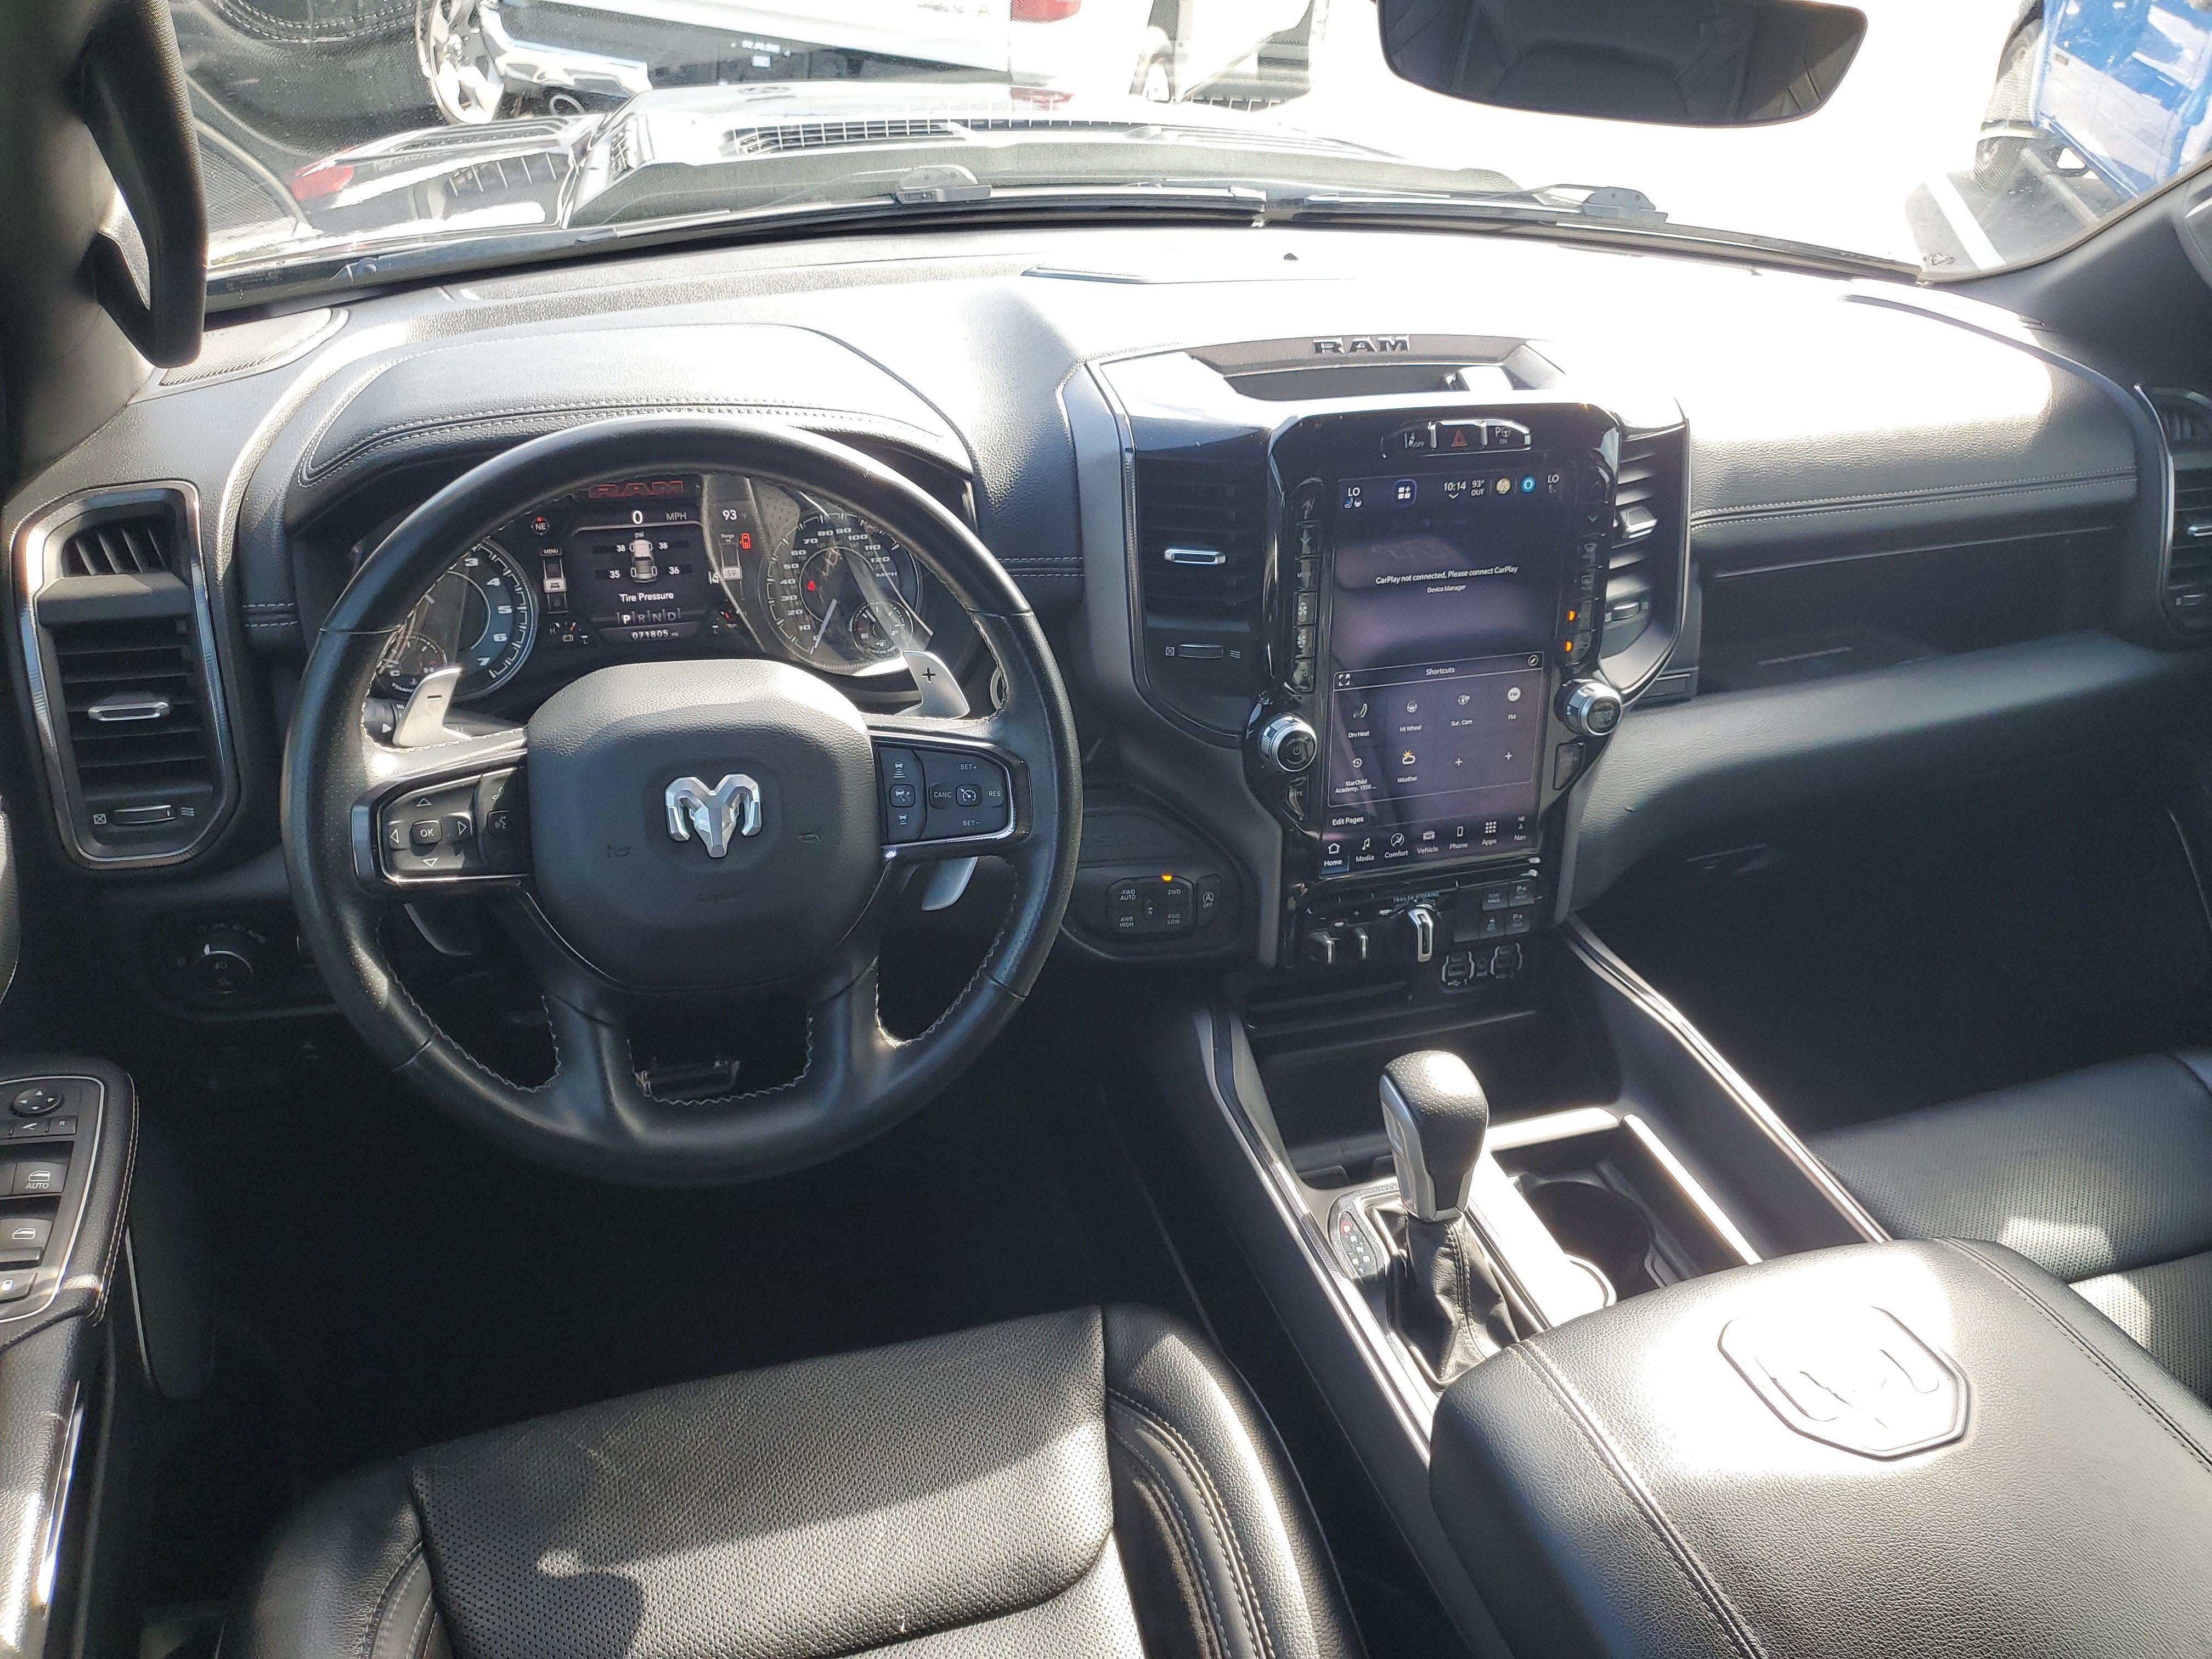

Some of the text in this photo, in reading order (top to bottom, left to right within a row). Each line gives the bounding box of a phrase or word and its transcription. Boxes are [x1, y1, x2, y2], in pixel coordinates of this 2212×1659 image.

[1312, 335, 1410, 354] RAM
[1547, 475, 1559, 483] LO
[589, 481, 683, 498] RAM
[1444, 481, 1466, 492] 10:14
[1348, 487, 1360, 496] LO
[633, 510, 687, 524] 0 MPH
[723, 509, 737, 521] 93
[464, 557, 479, 567] 3
[610, 571, 620, 579] 35
[668, 567, 679, 575] 36
[1376, 576, 1400, 584] CarPlay
[1413, 572, 1447, 582] connected,
[1469, 568, 1493, 576] connect
[1494, 566, 1519, 574] CarPlay
[486, 578, 500, 586] 4
[1444, 584, 1466, 592] Manager
[619, 592, 674, 602] Tire Pressure
[498, 605, 512, 614] 5
[624, 611, 675, 624] P R N D
[493, 633, 507, 642] 6
[632, 630, 668, 640] 071805
[477, 657, 490, 666] 7
[1426, 667, 1455, 675] Shortcuts
[1345, 816, 1364, 825] Pages
[420, 828, 434, 838] OK
[1385, 850, 1408, 859] Comfort
